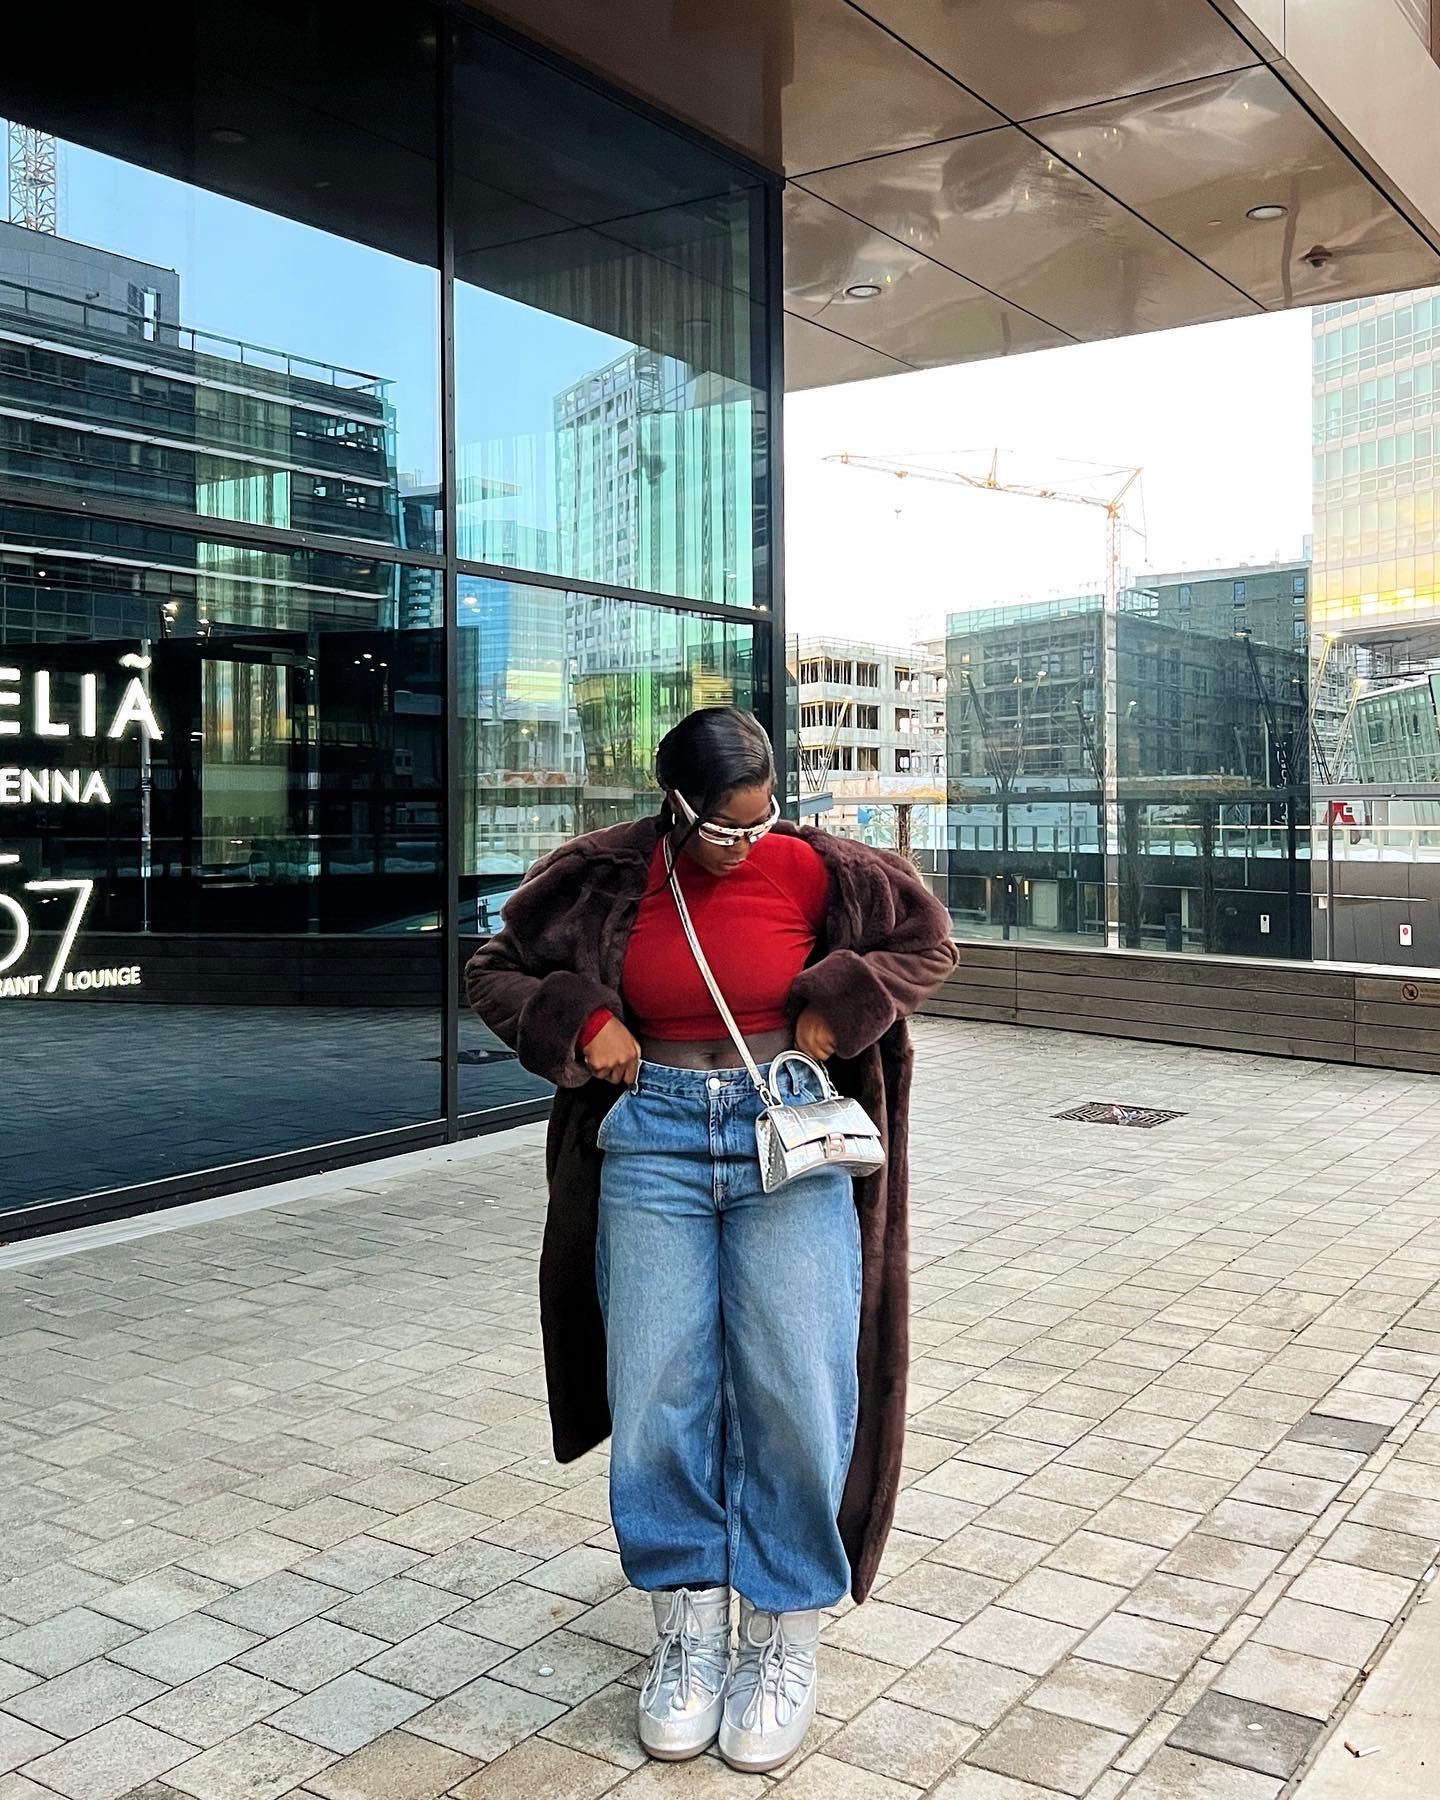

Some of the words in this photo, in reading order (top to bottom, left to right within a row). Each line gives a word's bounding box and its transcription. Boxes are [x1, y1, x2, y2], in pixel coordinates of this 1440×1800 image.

[0, 768, 111, 804] ENNA
[0, 975, 43, 997] ANT
[64, 965, 142, 991] LOUNGE
